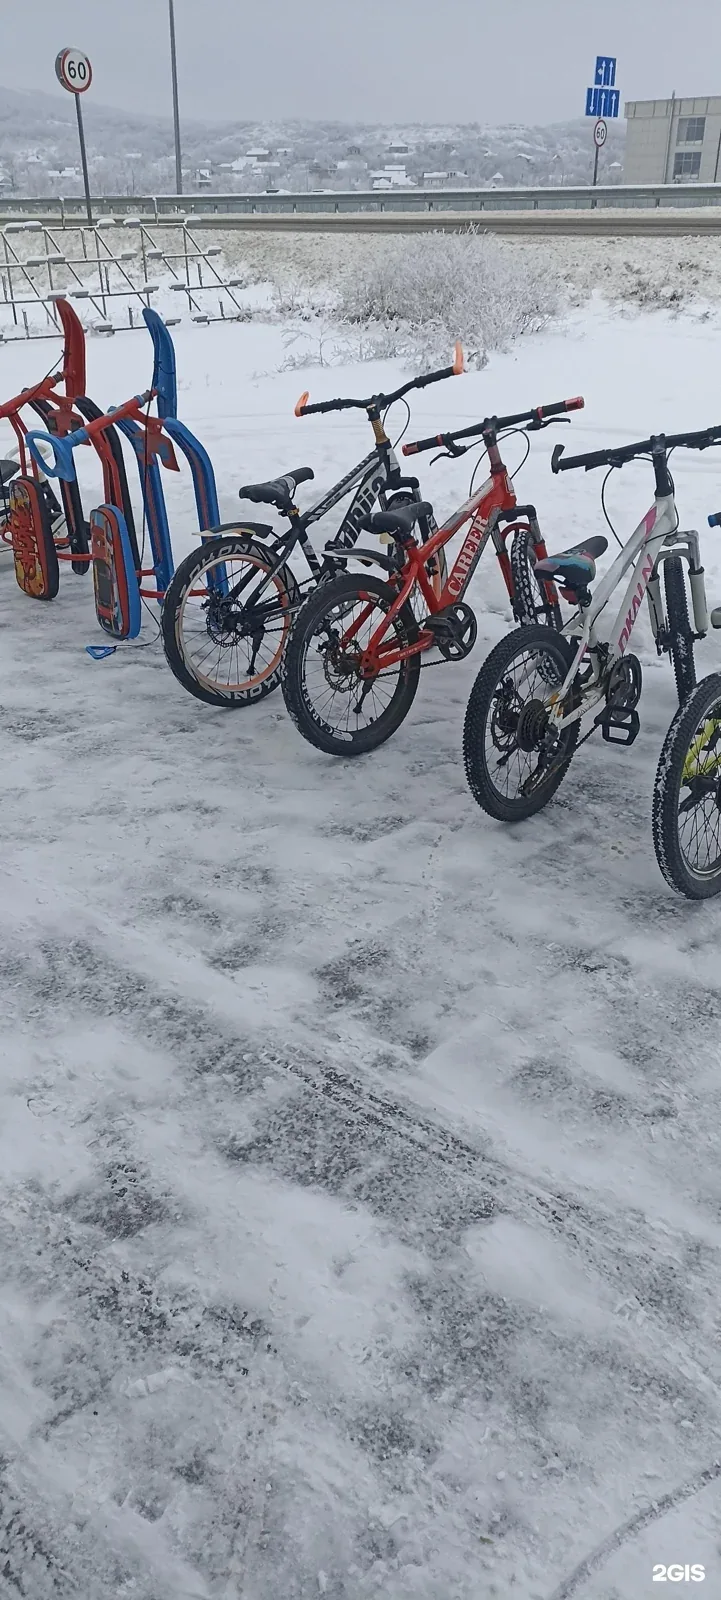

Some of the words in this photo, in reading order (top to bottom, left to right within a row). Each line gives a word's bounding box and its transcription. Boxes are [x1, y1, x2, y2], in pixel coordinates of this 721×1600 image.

[68, 60, 86, 80] 60
[596, 128, 605, 139] 60
[447, 514, 488, 597] CAREER
